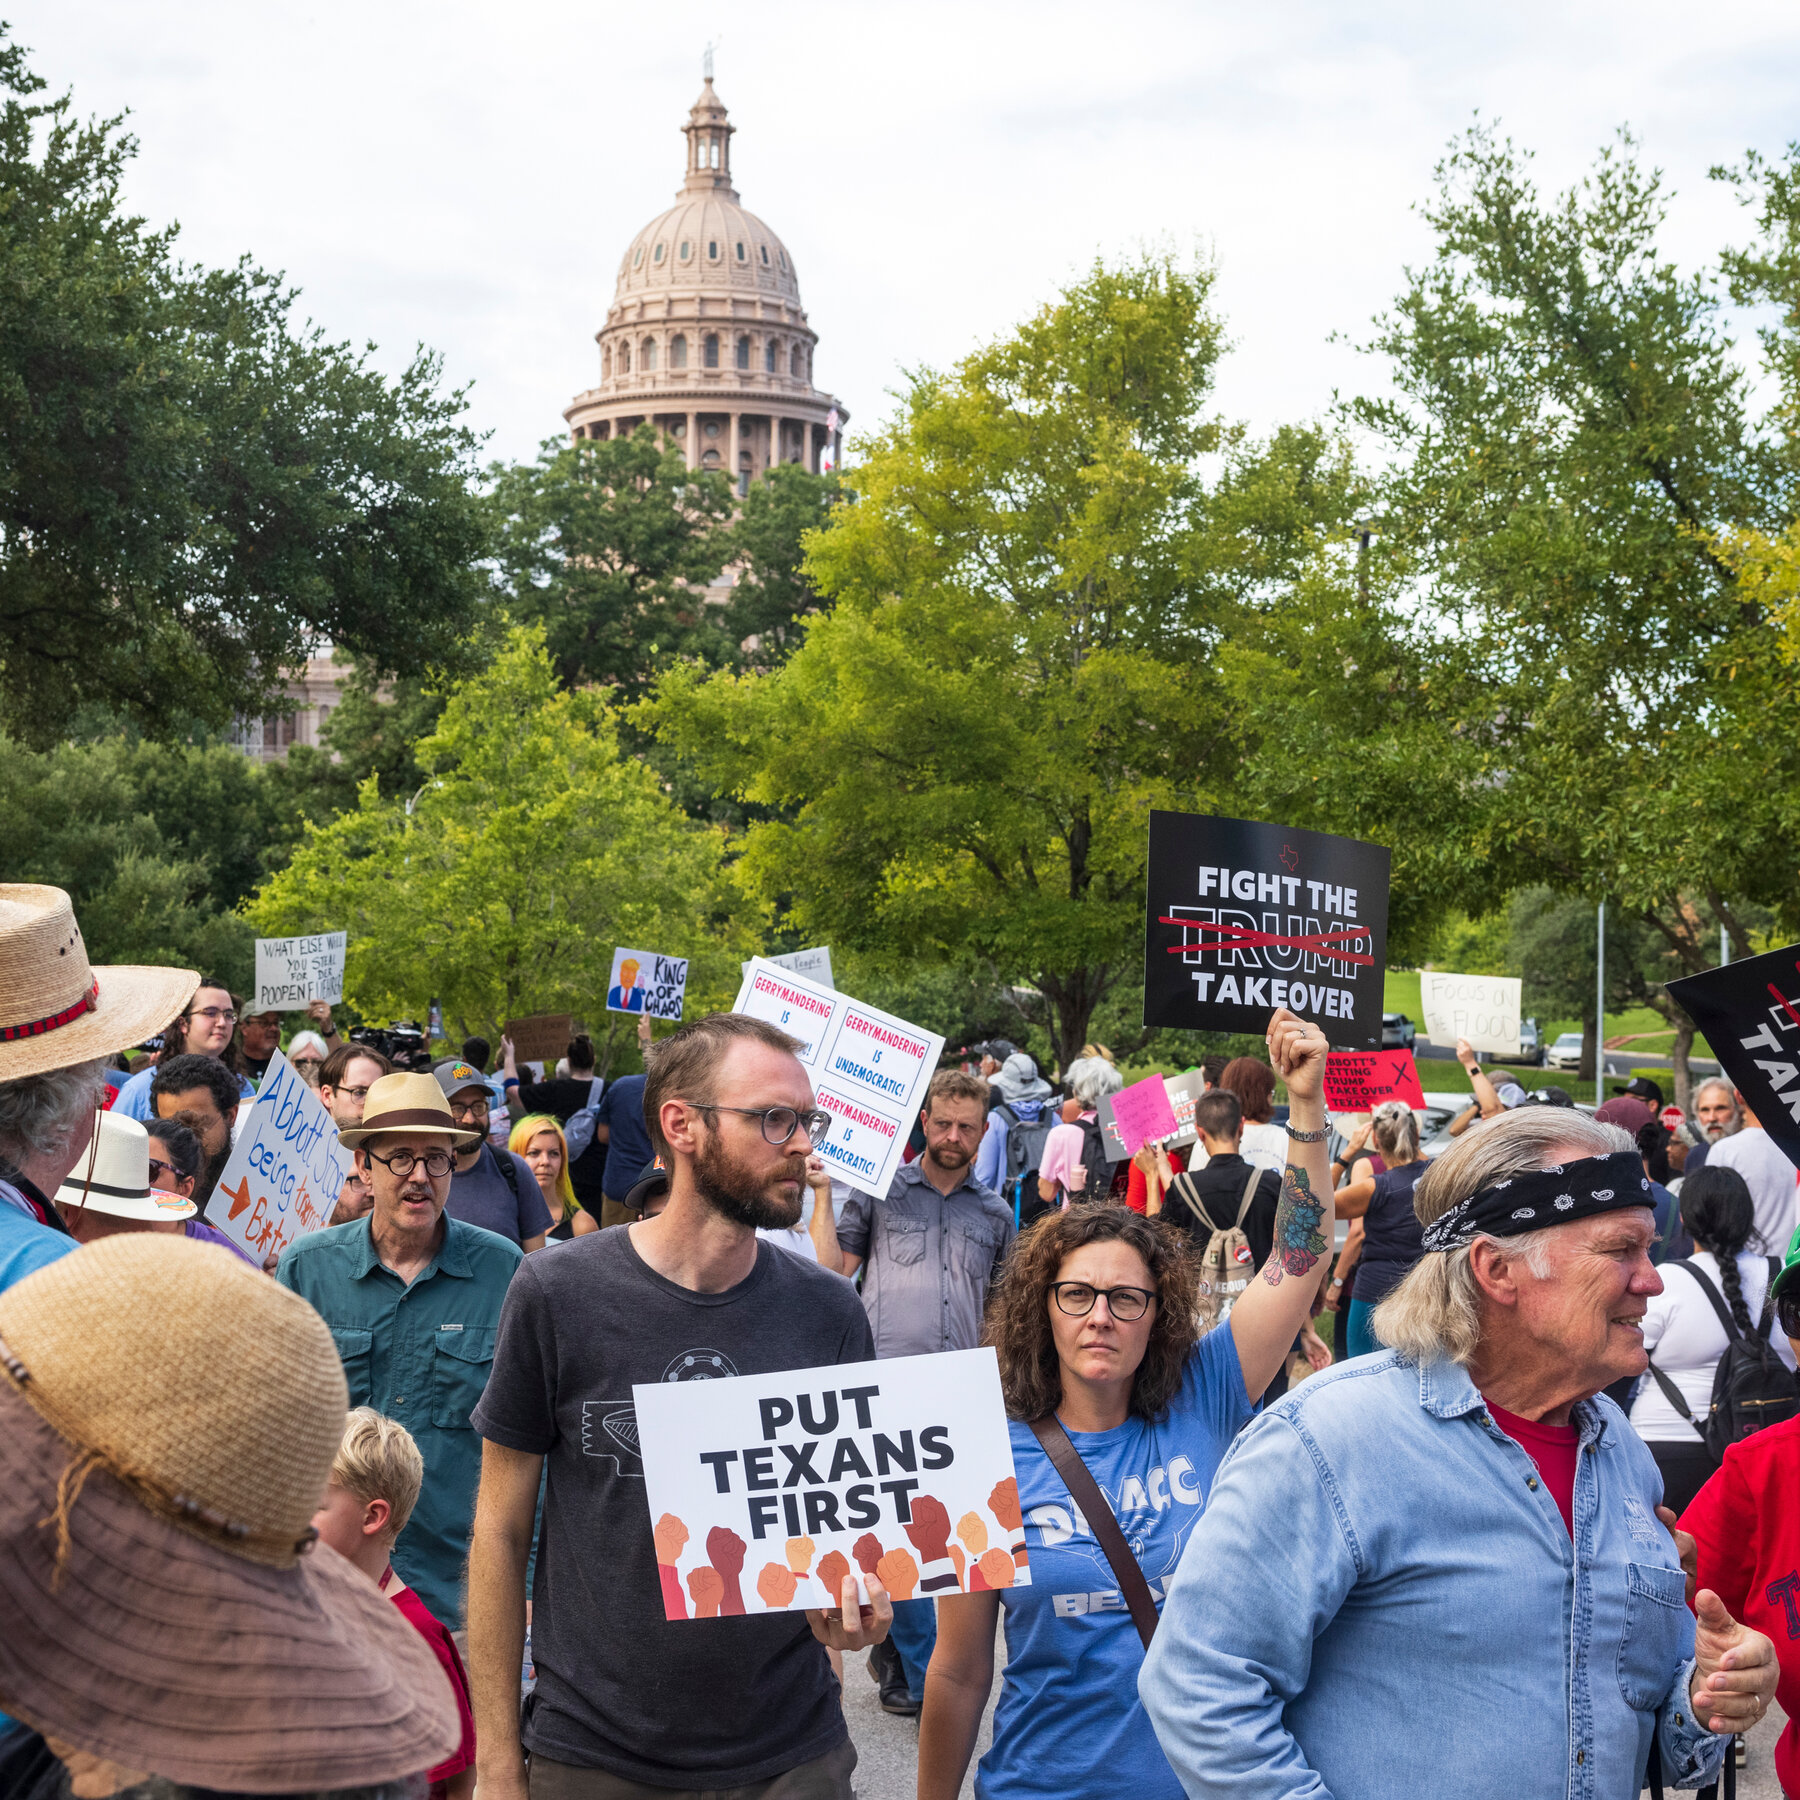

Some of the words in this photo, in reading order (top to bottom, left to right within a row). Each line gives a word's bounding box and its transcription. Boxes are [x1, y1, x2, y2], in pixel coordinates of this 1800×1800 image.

[1199, 866, 1301, 906] FIGHT
[1306, 879, 1358, 918] THE
[263, 940, 295, 958] WHAT
[300, 937, 323, 955] ELSE
[1169, 905, 1373, 980] TRUMP
[287, 959, 307, 973] YOU
[311, 954, 336, 970] STEAL
[290, 972, 308, 981] FOR
[317, 968, 333, 980] DER
[654, 956, 687, 986] KING
[645, 990, 682, 1019] CHAOS
[656, 986, 676, 999] OF
[754, 976, 832, 1019] GERRYMANDERING
[1191, 971, 1355, 1020] TAKEOVER
[1431, 977, 1485, 1001] FOCUS
[1493, 984, 1514, 1007] ON
[780, 1010, 790, 1024] IS
[1454, 1009, 1518, 1042] FLOOD
[845, 1014, 925, 1059] GERRYMANDERING
[872, 1049, 883, 1063] IS
[1326, 1058, 1377, 1067] BBOTT'S
[452, 1066, 473, 1080] 1889
[835, 1055, 905, 1097] UNDEMOCRATIC!
[1326, 1077, 1365, 1086] TRUMP
[1328, 1086, 1358, 1095] TAKE
[1360, 1086, 1394, 1096] OVER
[1332, 1098, 1369, 1108] TEXAS
[257, 1064, 328, 1168] Abbott
[816, 1092, 896, 1138] GERRYMANDERING
[1662, 1114, 1686, 1126] STOP
[842, 1127, 853, 1141] IS
[248, 1123, 297, 1213] being
[814, 1139, 876, 1175] DEMOCRATIC!
[758, 1385, 880, 1441] PUT
[699, 1425, 955, 1494] TEXANS
[747, 1478, 919, 1539] FIRST
